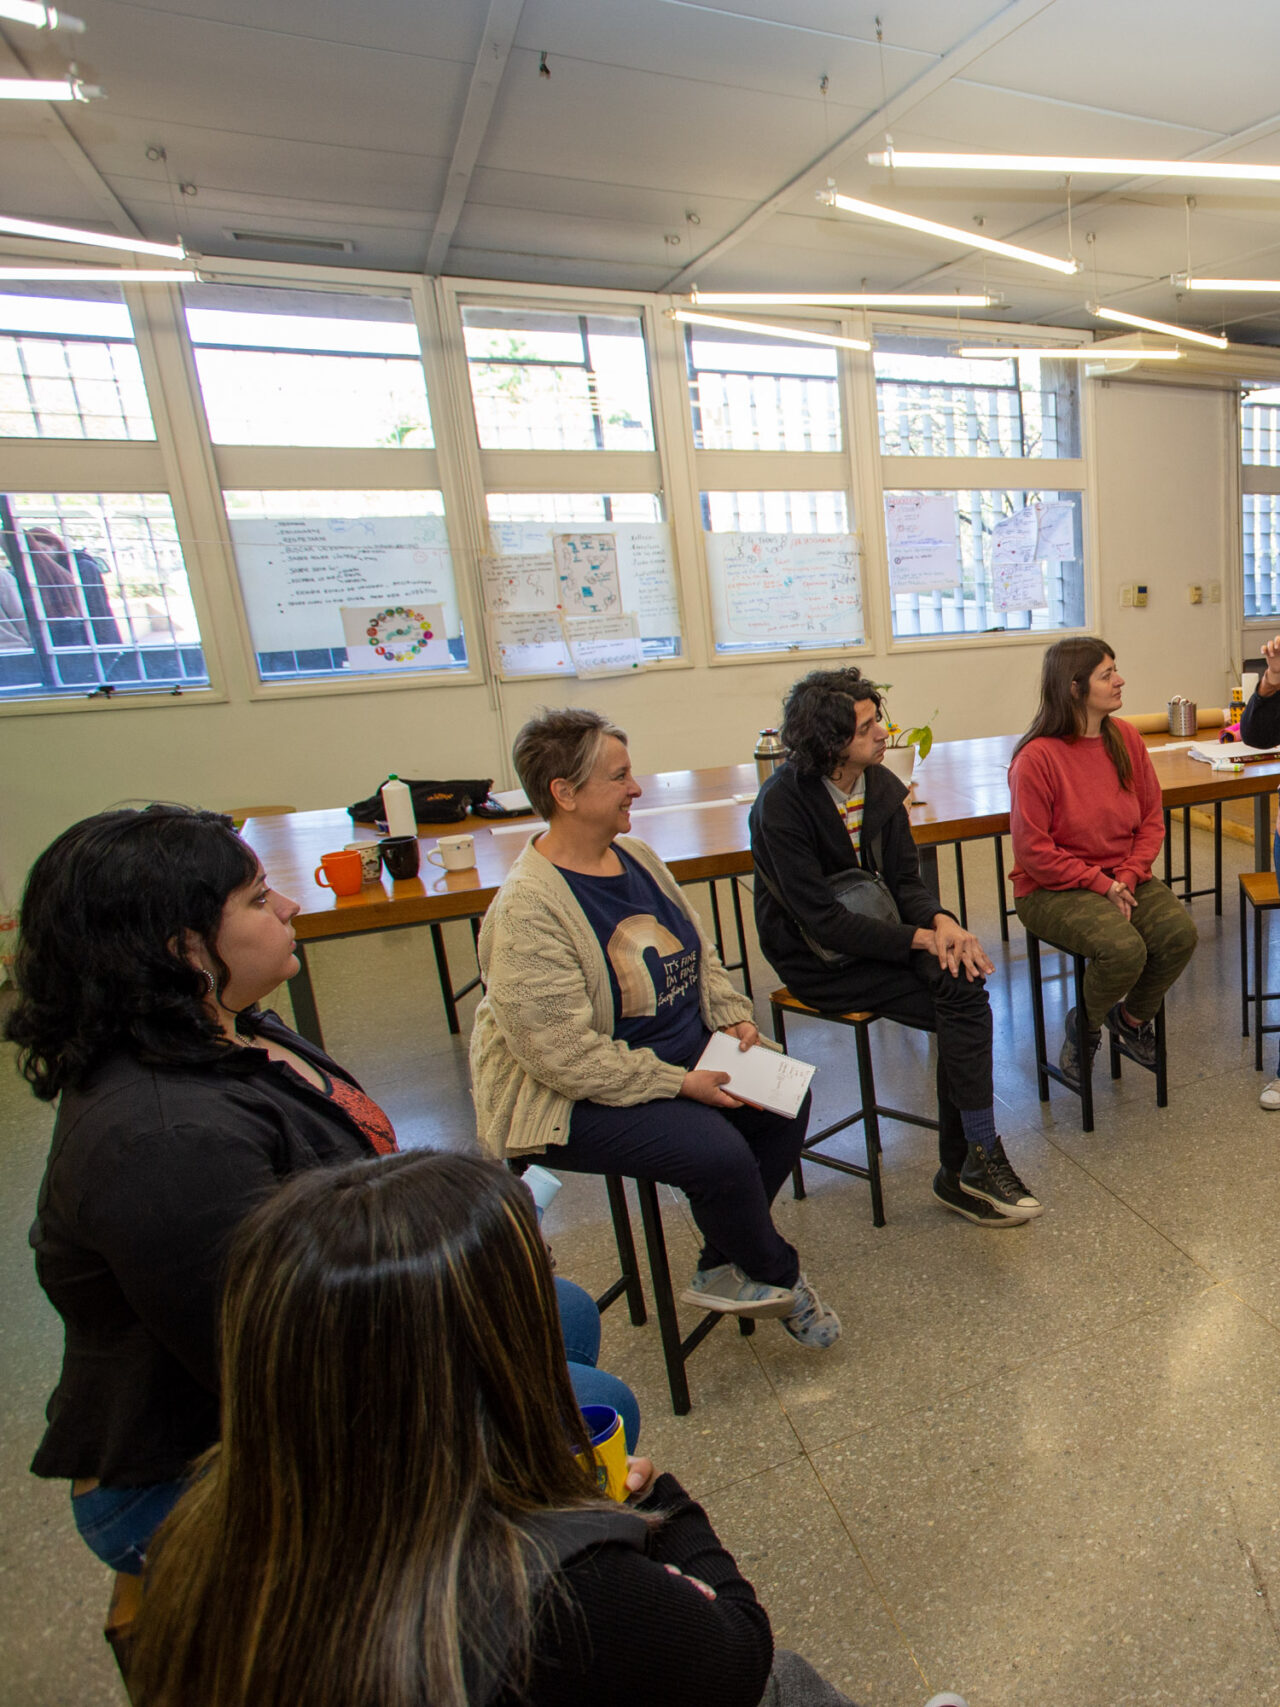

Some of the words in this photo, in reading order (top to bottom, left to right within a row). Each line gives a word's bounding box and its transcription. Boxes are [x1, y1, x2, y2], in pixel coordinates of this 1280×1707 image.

[664, 959, 679, 975] IT'S
[681, 950, 697, 968] FINE
[680, 962, 695, 980] FINE
